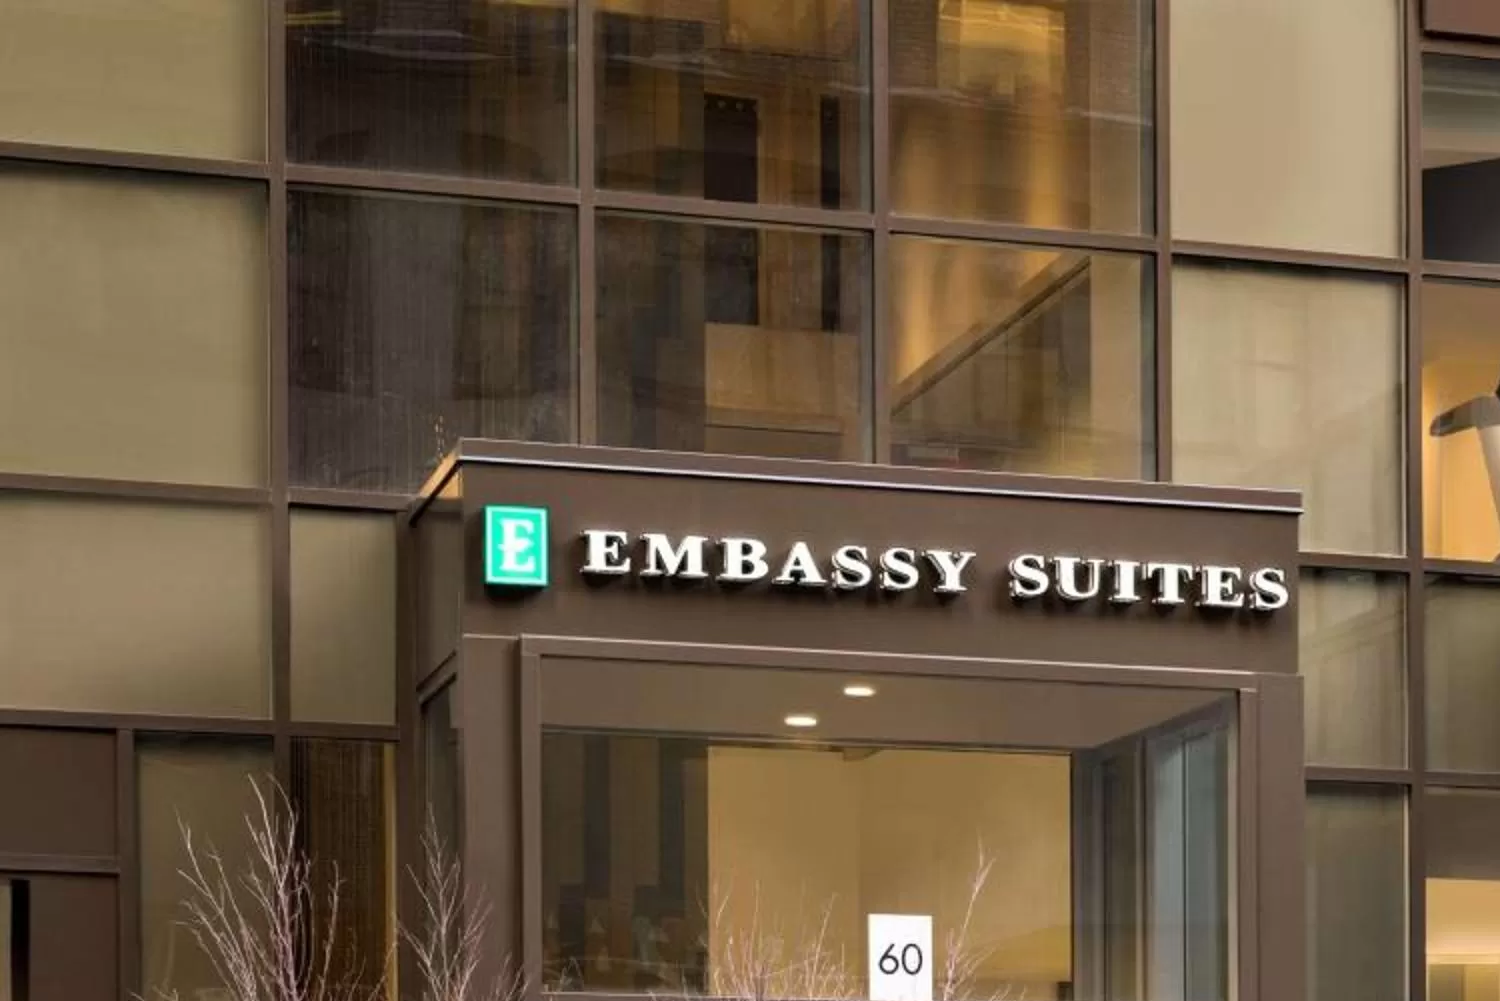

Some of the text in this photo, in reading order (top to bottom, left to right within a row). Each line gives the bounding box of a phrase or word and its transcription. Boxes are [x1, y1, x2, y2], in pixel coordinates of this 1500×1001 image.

[580, 529, 976, 592] EMBASSY
[1008, 554, 1289, 611] SUITES
[878, 943, 923, 975] 60
